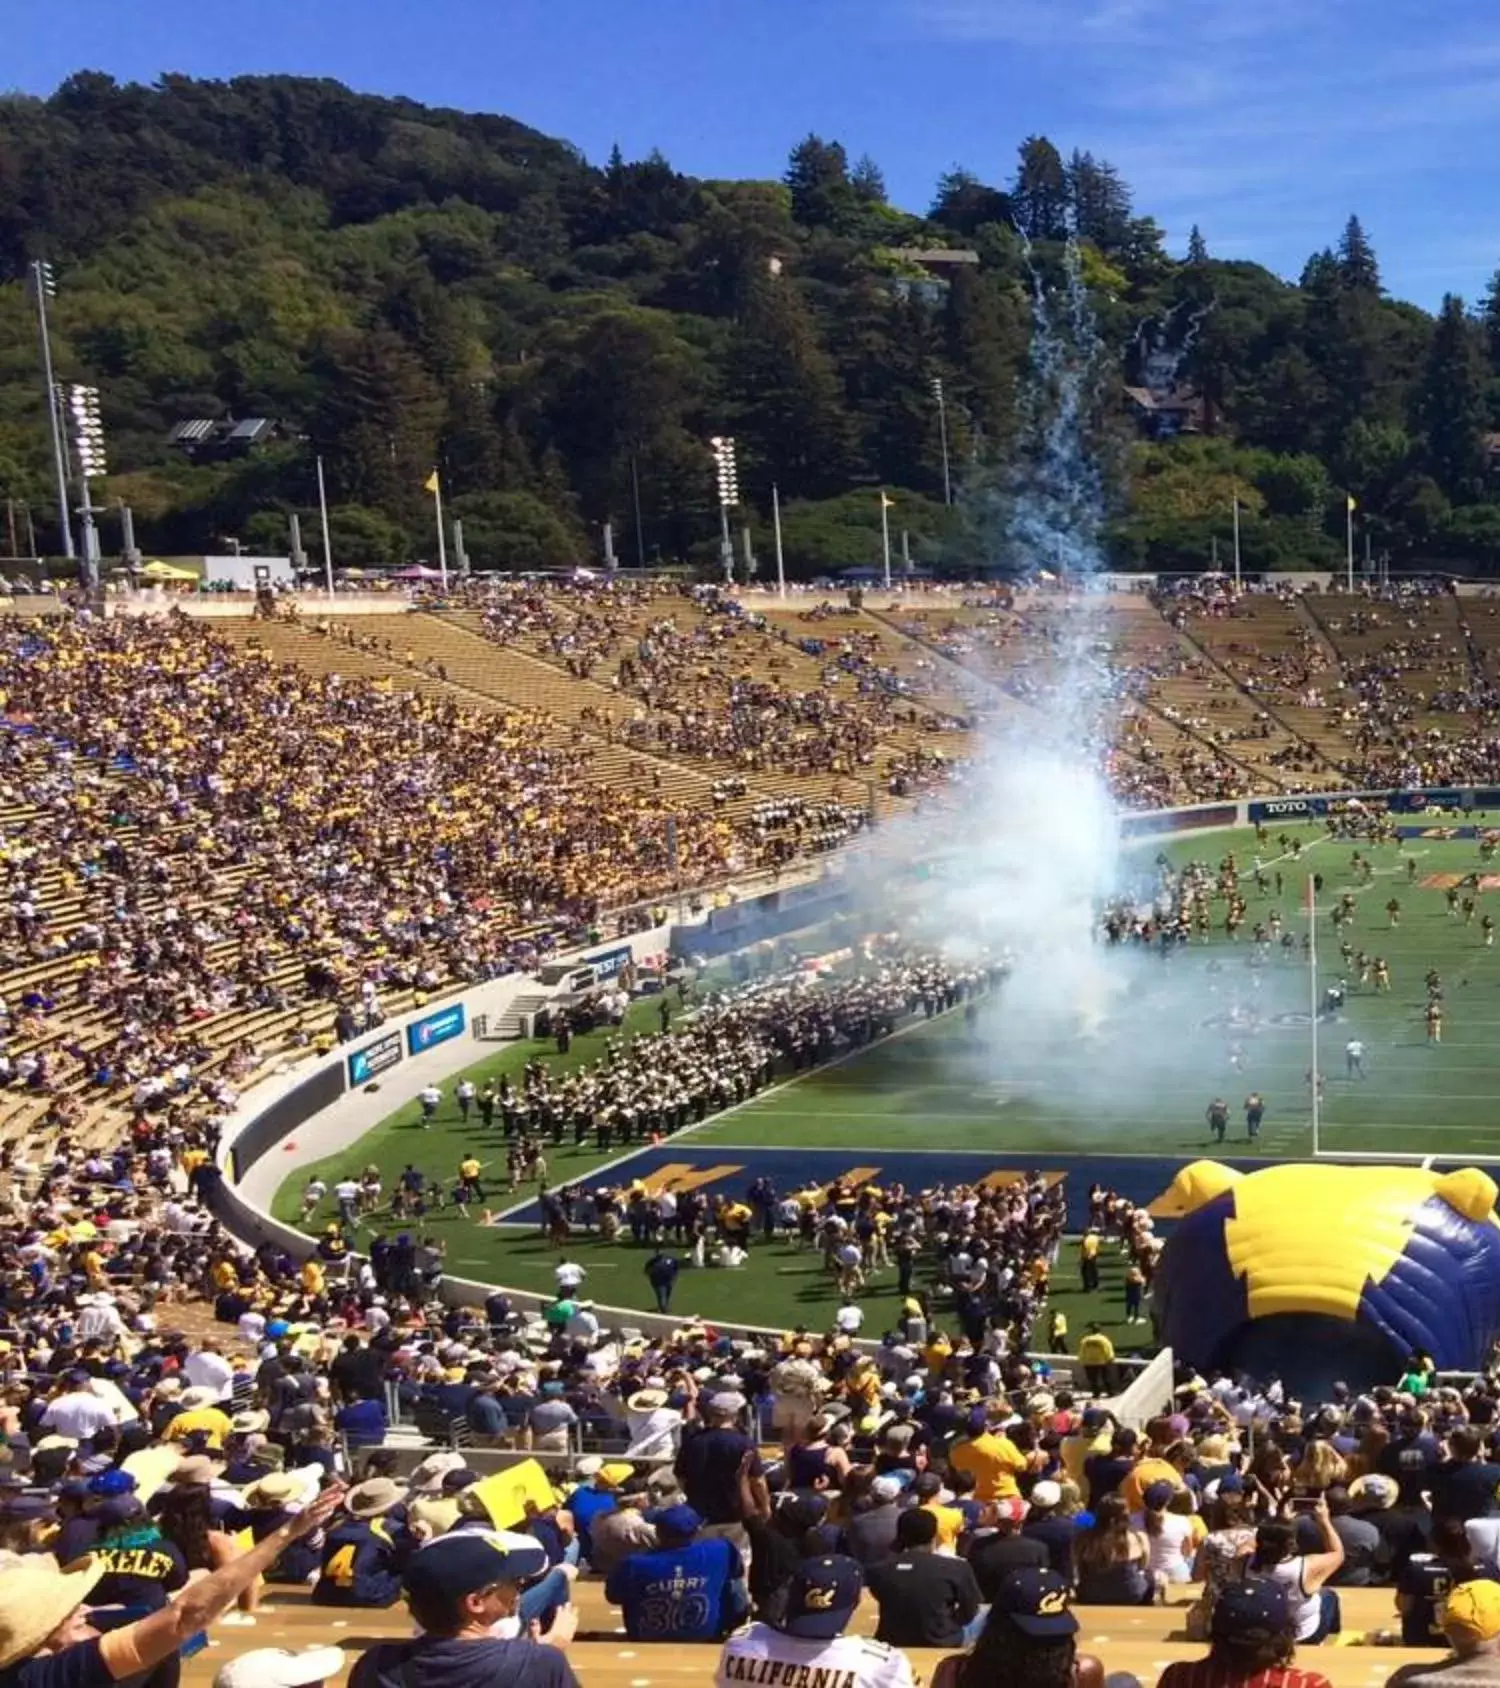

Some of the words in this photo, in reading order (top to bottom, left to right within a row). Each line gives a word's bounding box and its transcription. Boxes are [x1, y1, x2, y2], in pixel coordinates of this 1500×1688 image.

[1266, 801, 1307, 813] TOTO
[97, 1549, 174, 1578] KELEY
[645, 1576, 708, 1595] CURRY
[640, 1594, 710, 1632] 30
[724, 1654, 857, 1688] CALIFORNIA
